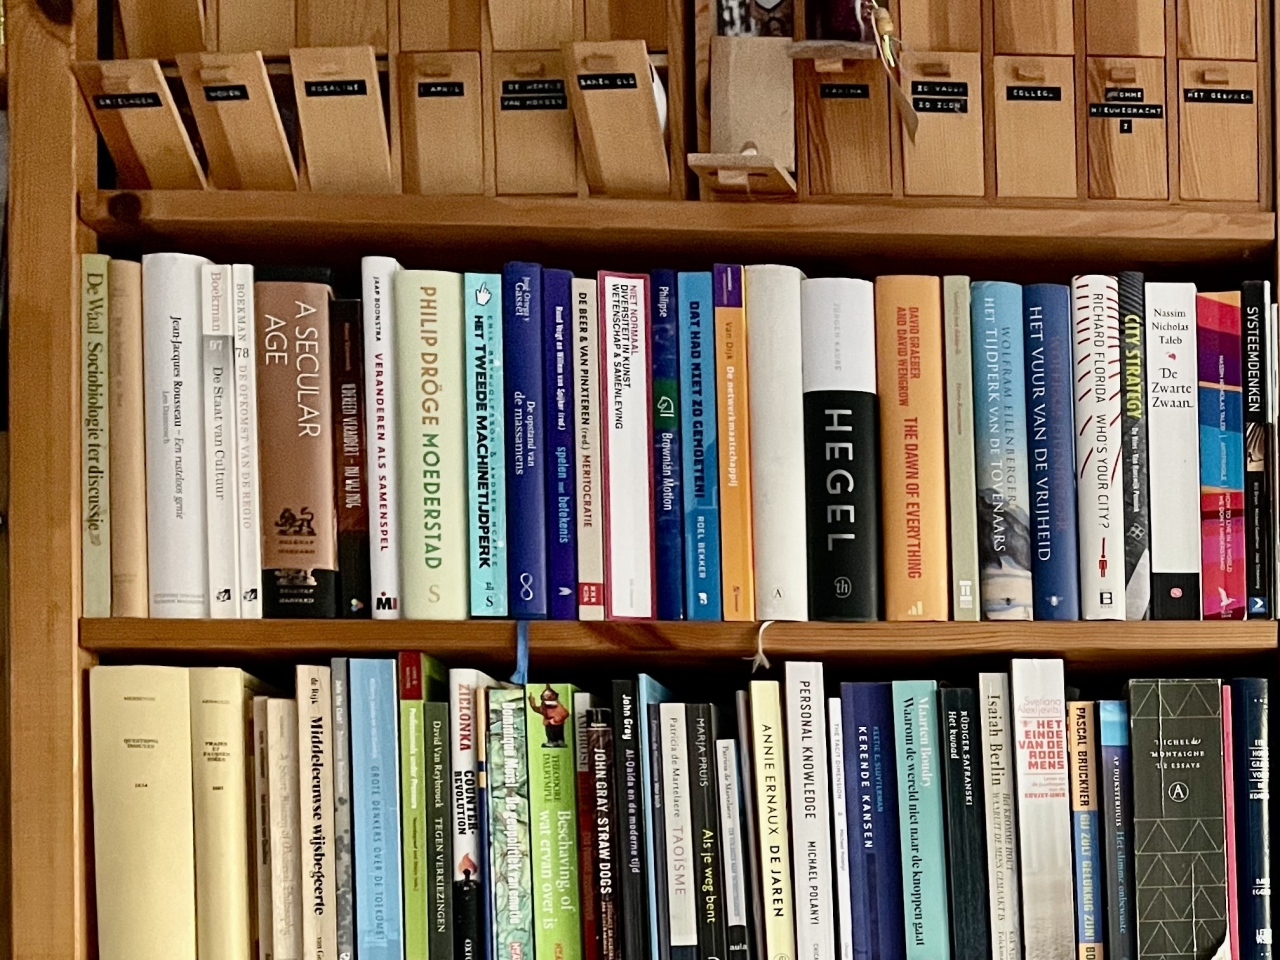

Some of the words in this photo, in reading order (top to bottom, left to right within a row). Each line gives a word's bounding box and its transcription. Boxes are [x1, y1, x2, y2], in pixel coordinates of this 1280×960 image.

[1012, 89, 1054, 98] COLLEG
[87, 273, 104, 294] De
[294, 300, 316, 318] A
[88, 295, 104, 334] Waal
[265, 314, 287, 366] AGE
[420, 286, 438, 347] PHILIP
[1093, 294, 1106, 348] RICHARD
[1124, 314, 1140, 345] CITY
[296, 326, 321, 437] SECULAR
[1094, 352, 1106, 403] FLORIDA
[1126, 349, 1142, 419] STRATEGY
[1247, 306, 1260, 412] SYSTEEMDENKEN
[86, 342, 105, 440] Sociobiologie
[375, 353, 385, 441] VERANDEREN
[422, 352, 442, 425] DRÖGE
[87, 443, 103, 462] ter
[377, 446, 386, 469] ALS
[1096, 414, 1108, 453] WHO'S
[86, 465, 104, 531] discussie
[423, 433, 442, 569] MOEDERSTAD
[824, 408, 855, 551] HEGEL
[1096, 458, 1109, 490] YOUR
[378, 475, 389, 552] SAMENSPEL
[1098, 494, 1110, 529] CITY?
[458, 683, 472, 751] ZIELONKA
[799, 680, 813, 742] PERSONAL
[1076, 707, 1087, 746] PASCAL
[309, 716, 326, 820] Middeleeuwse
[594, 748, 607, 778] JOHN
[802, 746, 816, 819] KNOWLEDGE
[858, 726, 870, 787] KERENDE
[1077, 751, 1089, 807] BRUCKNER
[453, 771, 466, 835] REVOLUTION
[463, 770, 476, 835] COUNTER-
[596, 781, 608, 812] GRAY
[862, 795, 873, 849] KANSEN
[597, 817, 610, 860] STRAW
[807, 841, 818, 882] MICHAEL
[309, 824, 325, 915] wijsbegeerte
[599, 863, 612, 894] DOGS
[809, 885, 820, 925] POLANYI
